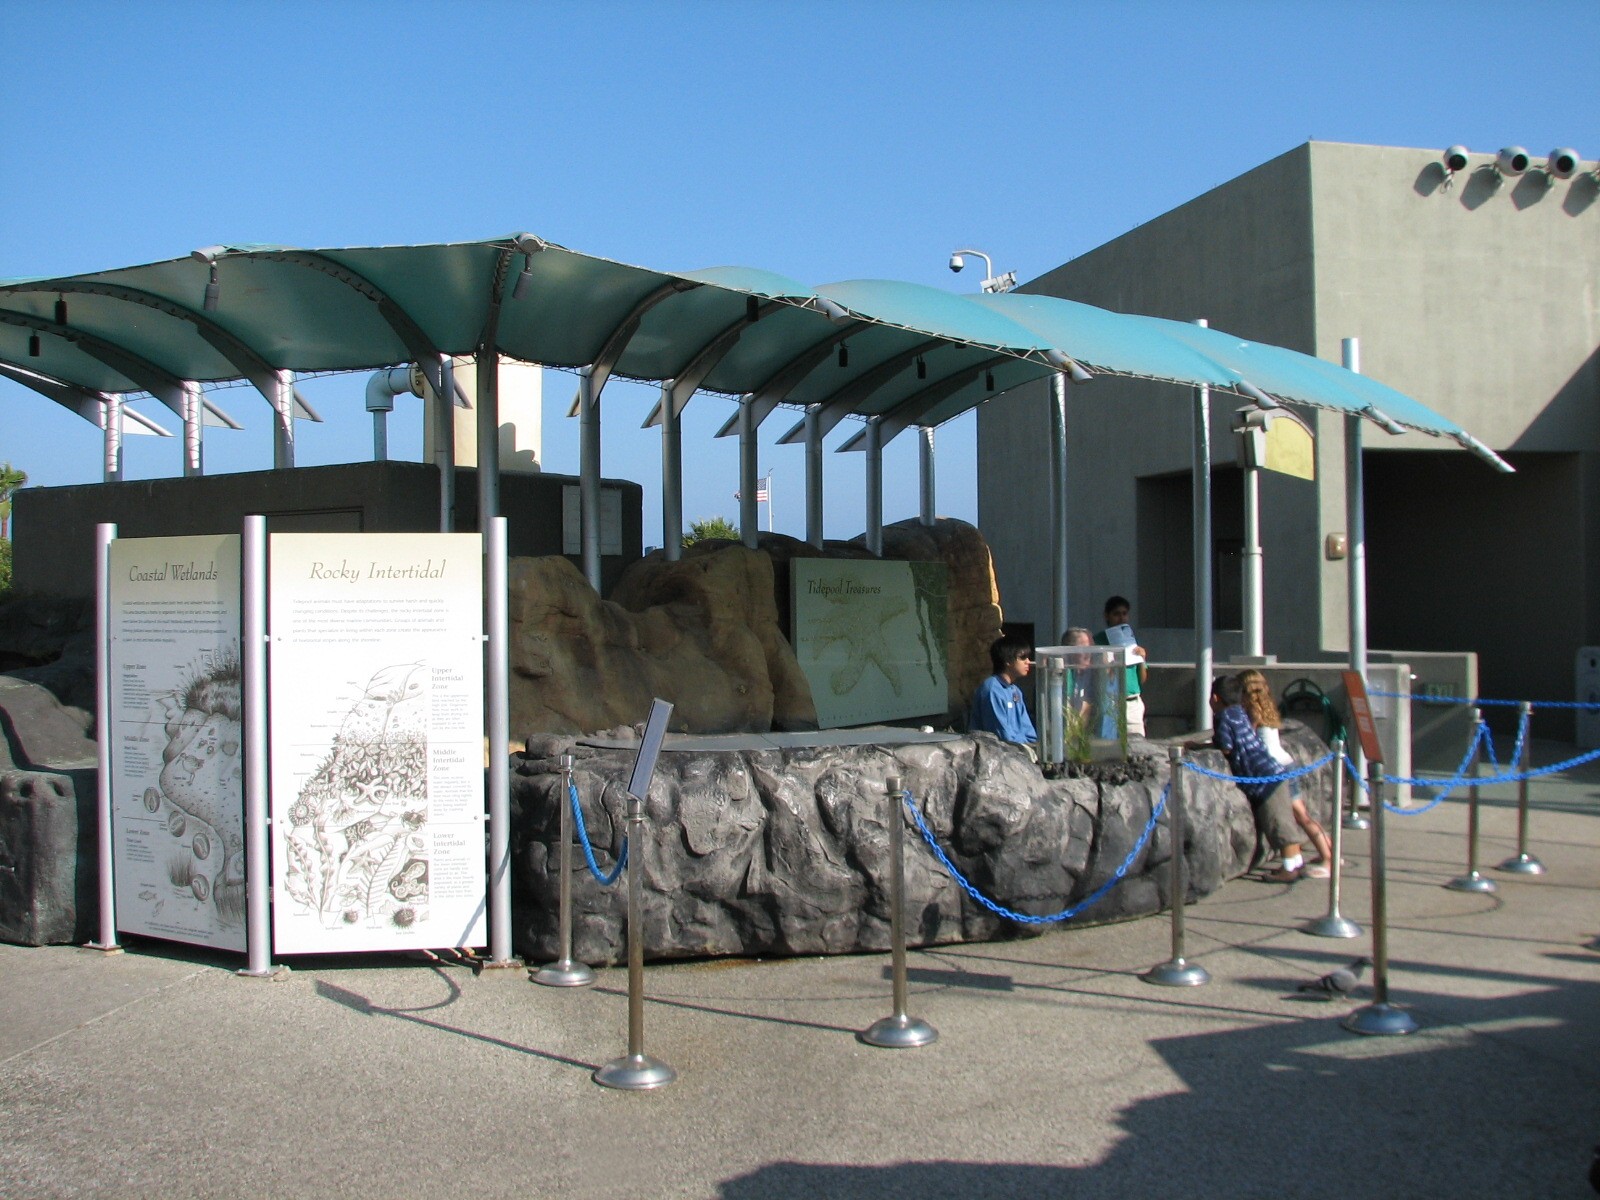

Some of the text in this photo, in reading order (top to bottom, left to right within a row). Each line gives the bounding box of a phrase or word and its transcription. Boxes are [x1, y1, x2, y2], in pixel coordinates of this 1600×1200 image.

[129, 561, 218, 582] Coastal Wetlands
[308, 558, 446, 584] Rocky Intertidal
[807, 578, 881, 597] Tidepool Treasures
[431, 667, 453, 675] Upper
